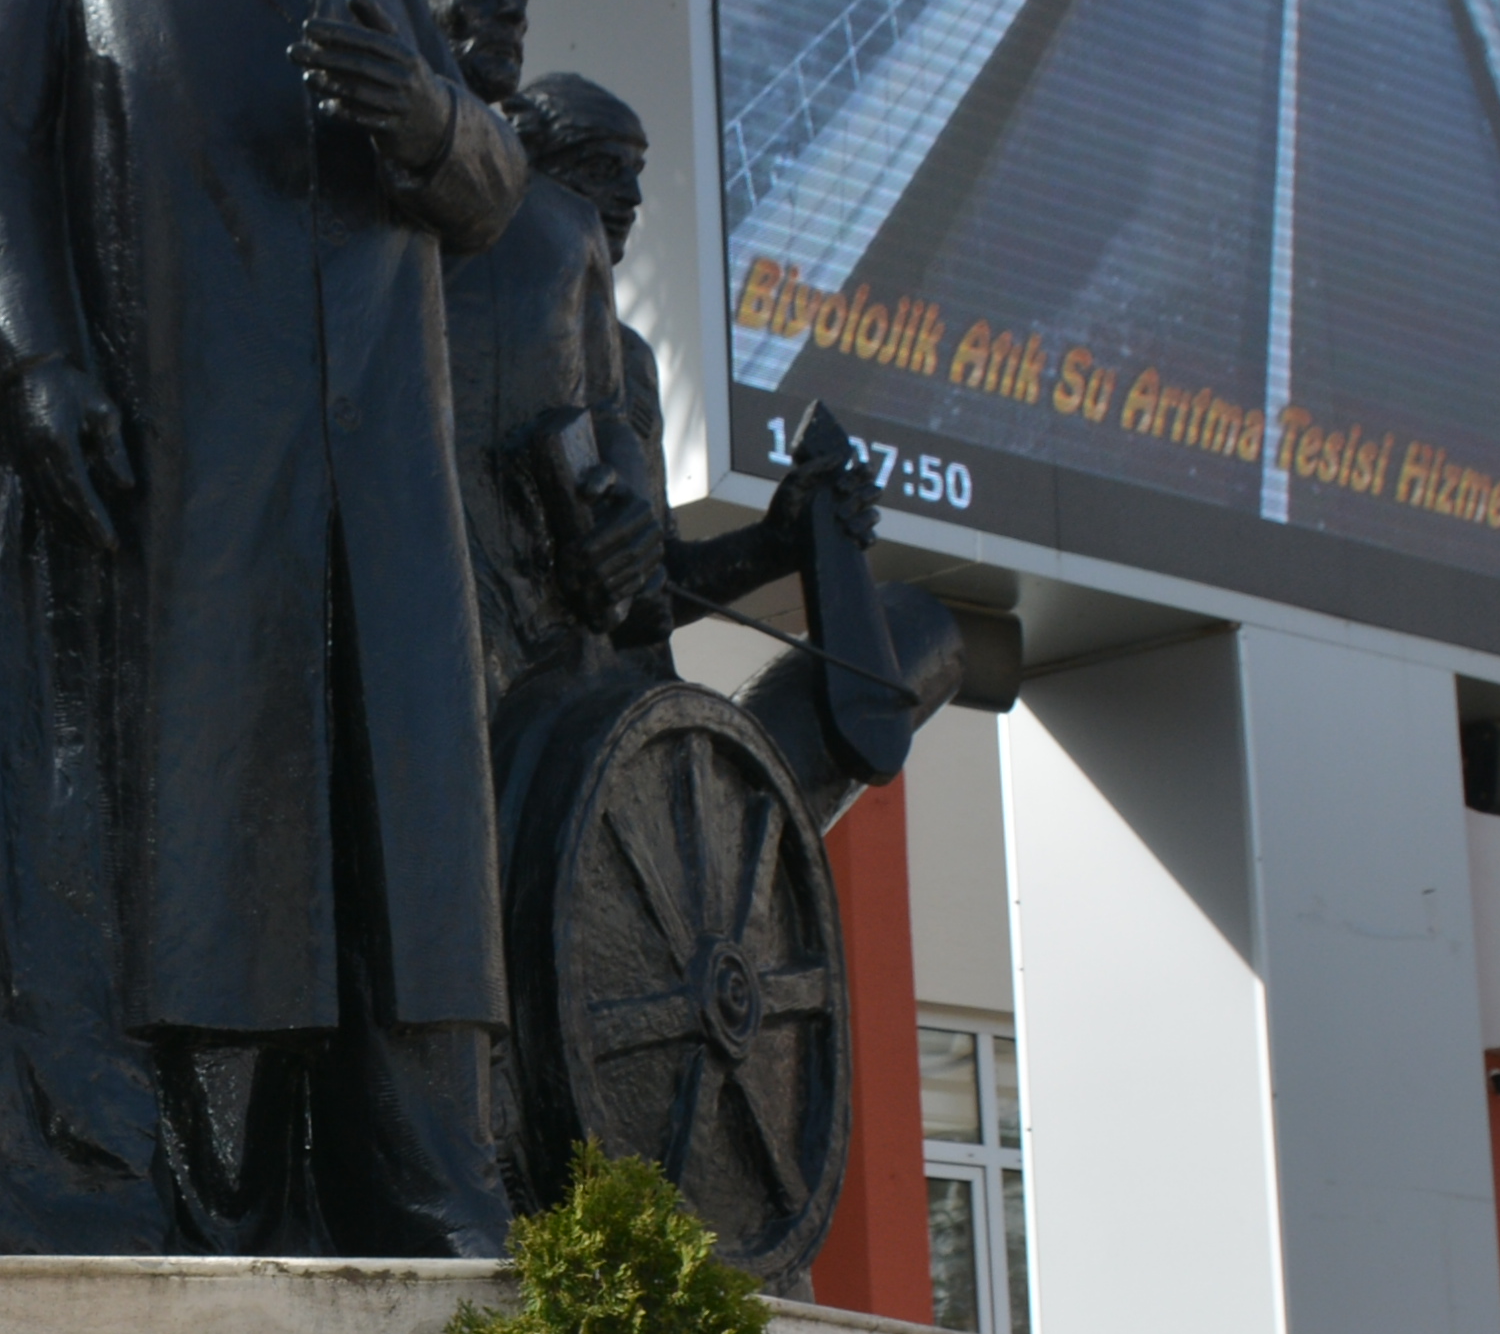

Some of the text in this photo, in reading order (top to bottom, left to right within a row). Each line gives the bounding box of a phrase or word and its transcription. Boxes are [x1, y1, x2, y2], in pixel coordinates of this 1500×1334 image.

[736, 256, 946, 377] Biyolojik
[949, 319, 1047, 404] Atık
[1053, 347, 1117, 424] Su
[1121, 366, 1264, 462] Arıtma
[1276, 406, 1394, 496] Tesisi
